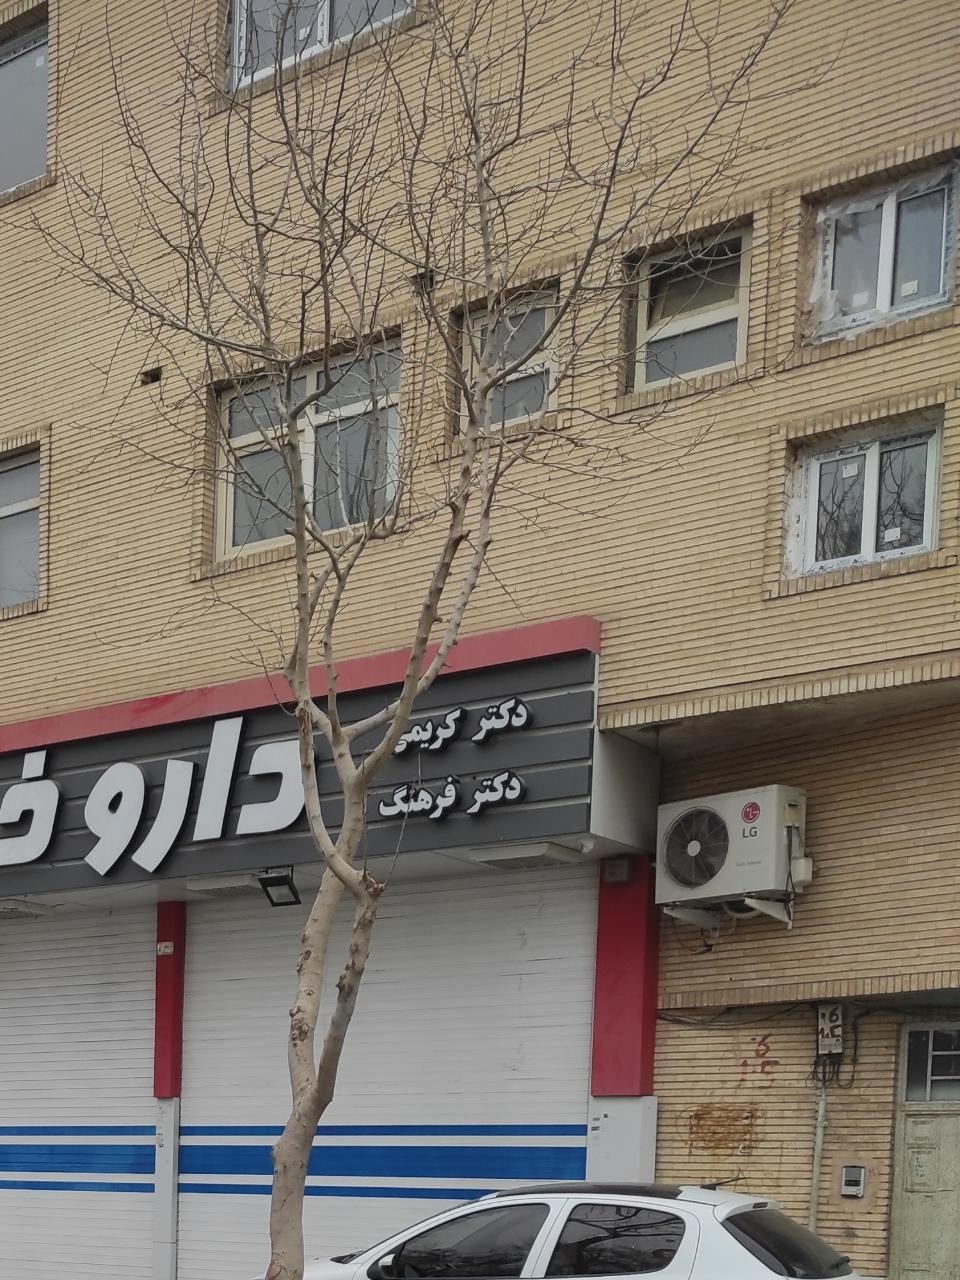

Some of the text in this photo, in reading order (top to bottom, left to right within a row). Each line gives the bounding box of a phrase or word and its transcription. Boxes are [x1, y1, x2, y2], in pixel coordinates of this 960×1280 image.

[472, 699, 527, 740] دکتر
[379, 772, 521, 819] دکتر فرهنگ
[742, 826, 758, 838] LG
